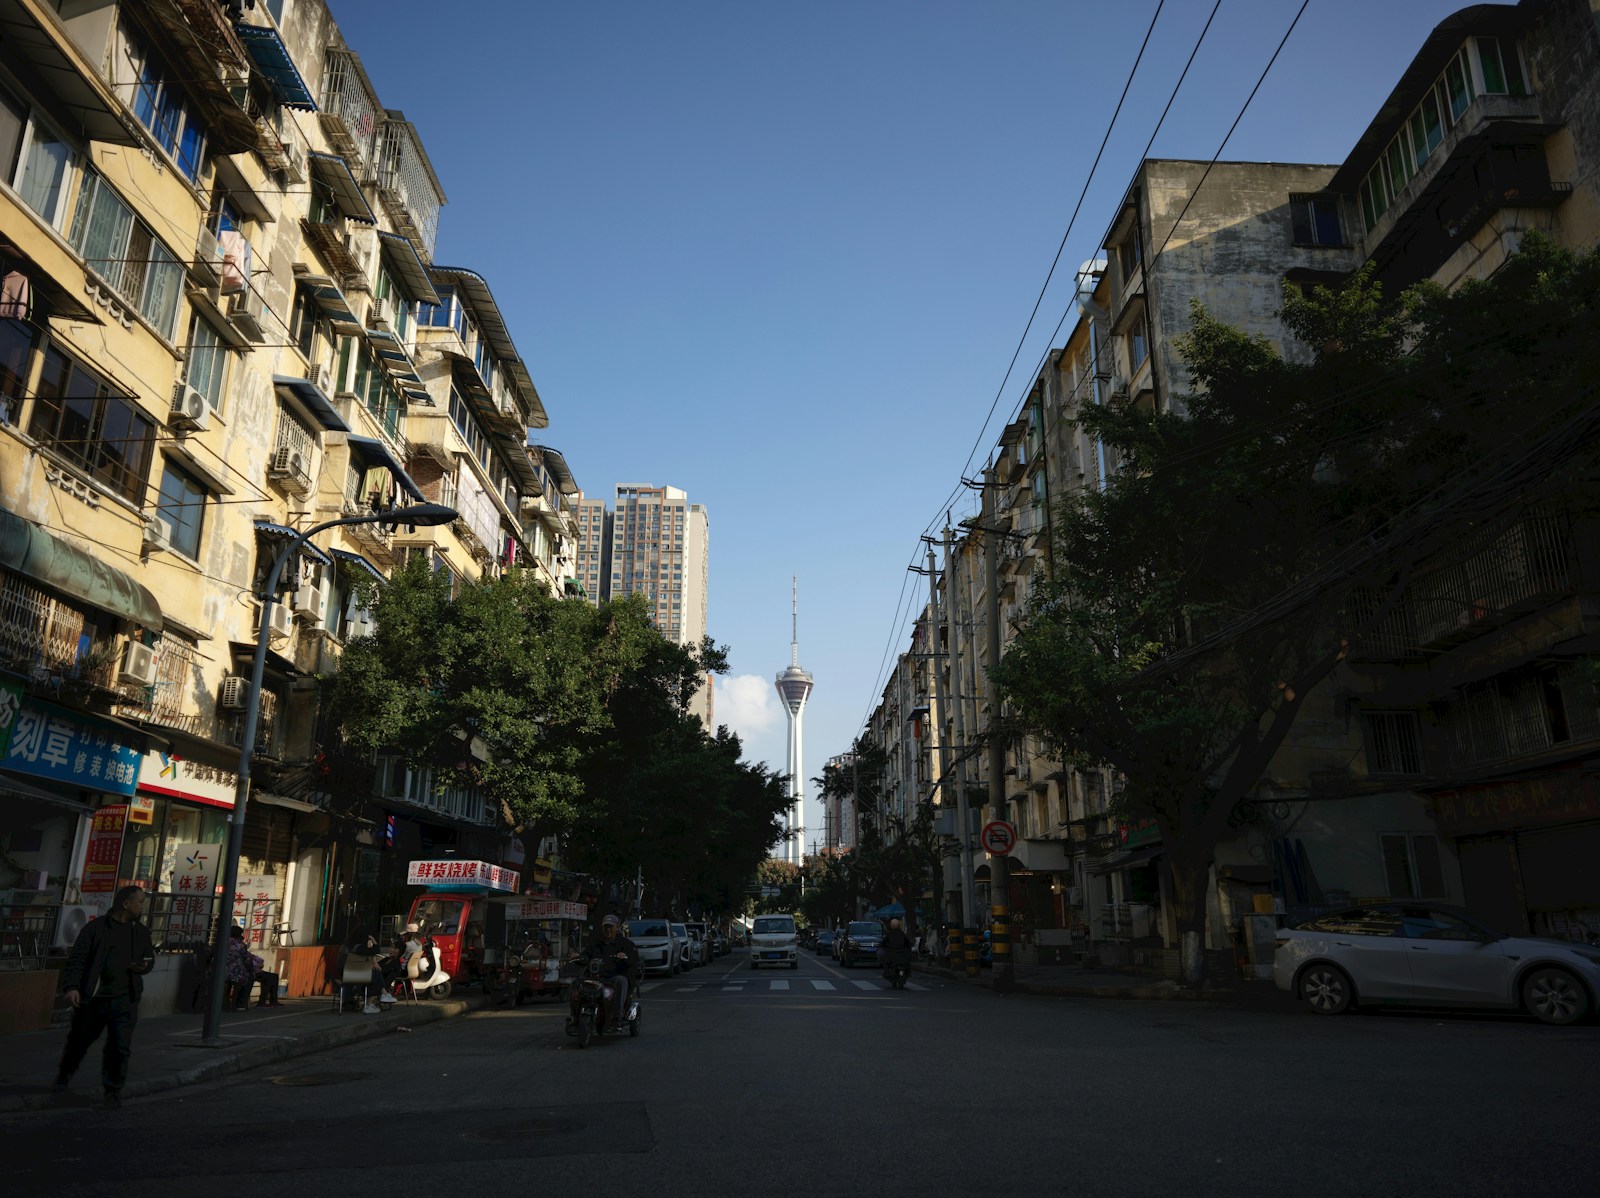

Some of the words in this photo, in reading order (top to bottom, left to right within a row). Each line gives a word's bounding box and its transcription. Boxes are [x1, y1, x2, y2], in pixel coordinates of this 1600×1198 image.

[10, 706, 75, 768] 刻章
[73, 750, 135, 785] 修表换电池
[92, 815, 123, 831] 报名处
[416, 862, 478, 878] 鲜货烧烤
[178, 875, 208, 891] 体彩
